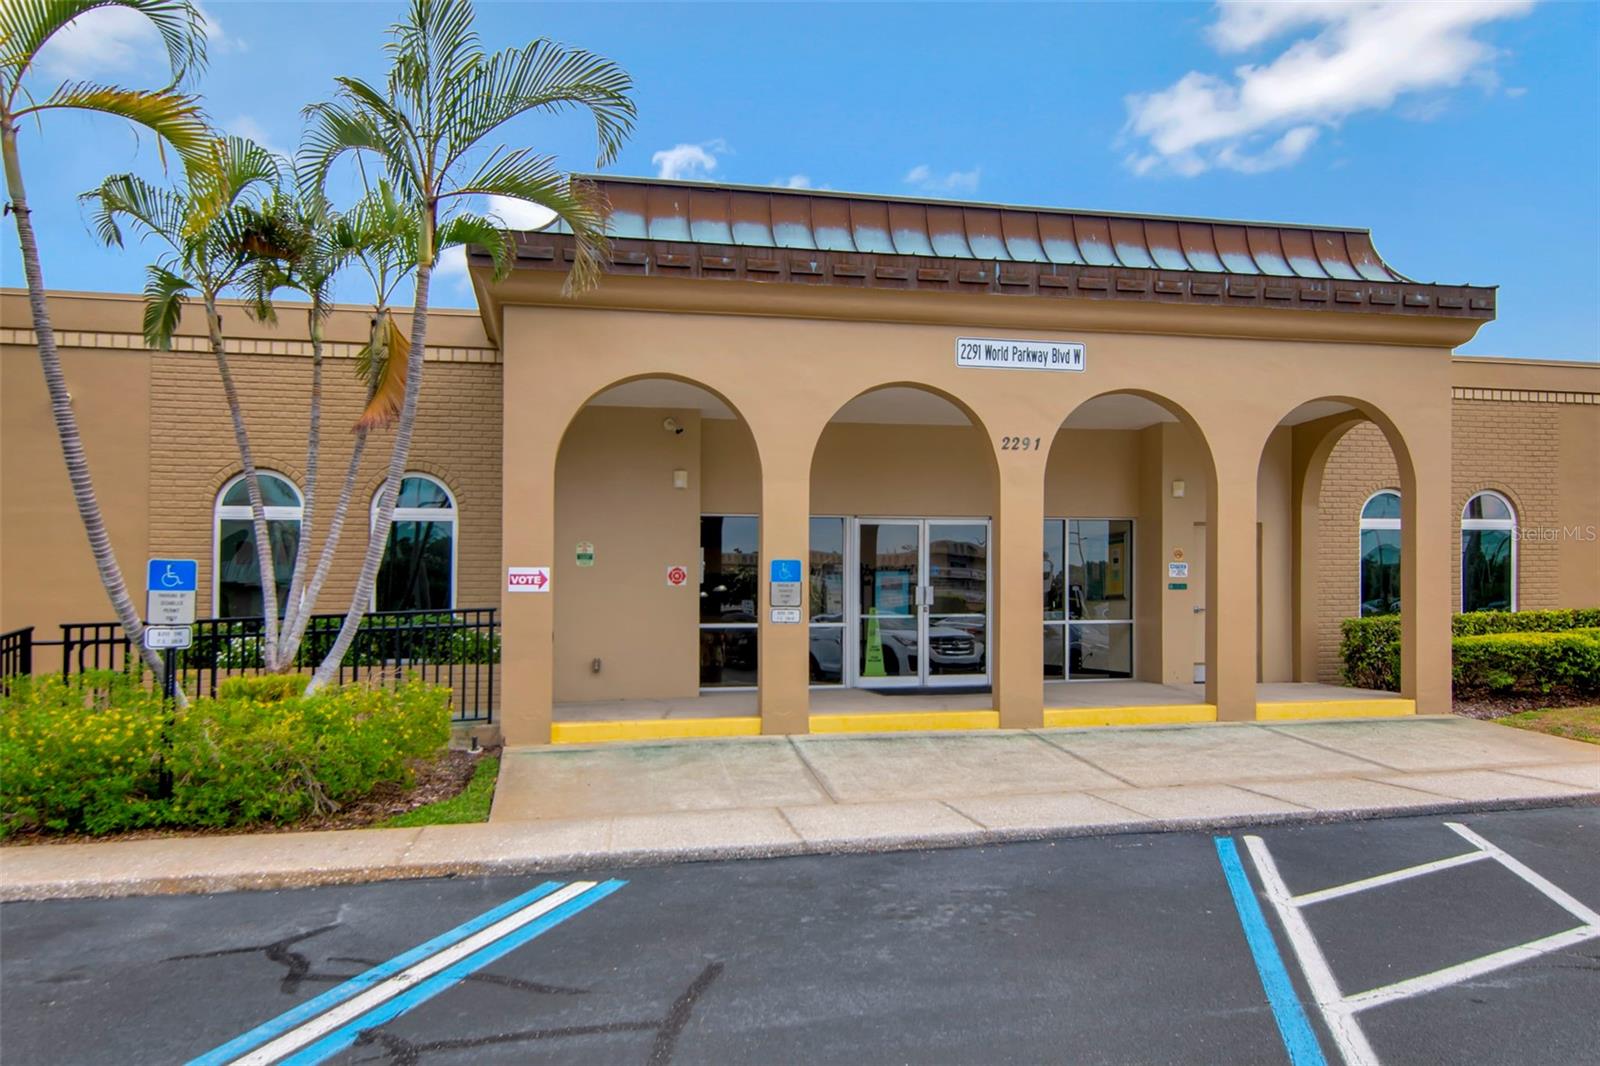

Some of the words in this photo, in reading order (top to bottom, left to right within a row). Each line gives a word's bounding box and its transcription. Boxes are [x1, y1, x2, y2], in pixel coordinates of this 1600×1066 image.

[961, 344, 981, 360] 2291
[985, 345, 1009, 361] World
[1012, 346, 1049, 367] Parkway
[1052, 348, 1070, 364] Blvd
[1074, 349, 1082, 364] W
[1001, 436, 1041, 450] 2291
[510, 575, 542, 584] VOTE
